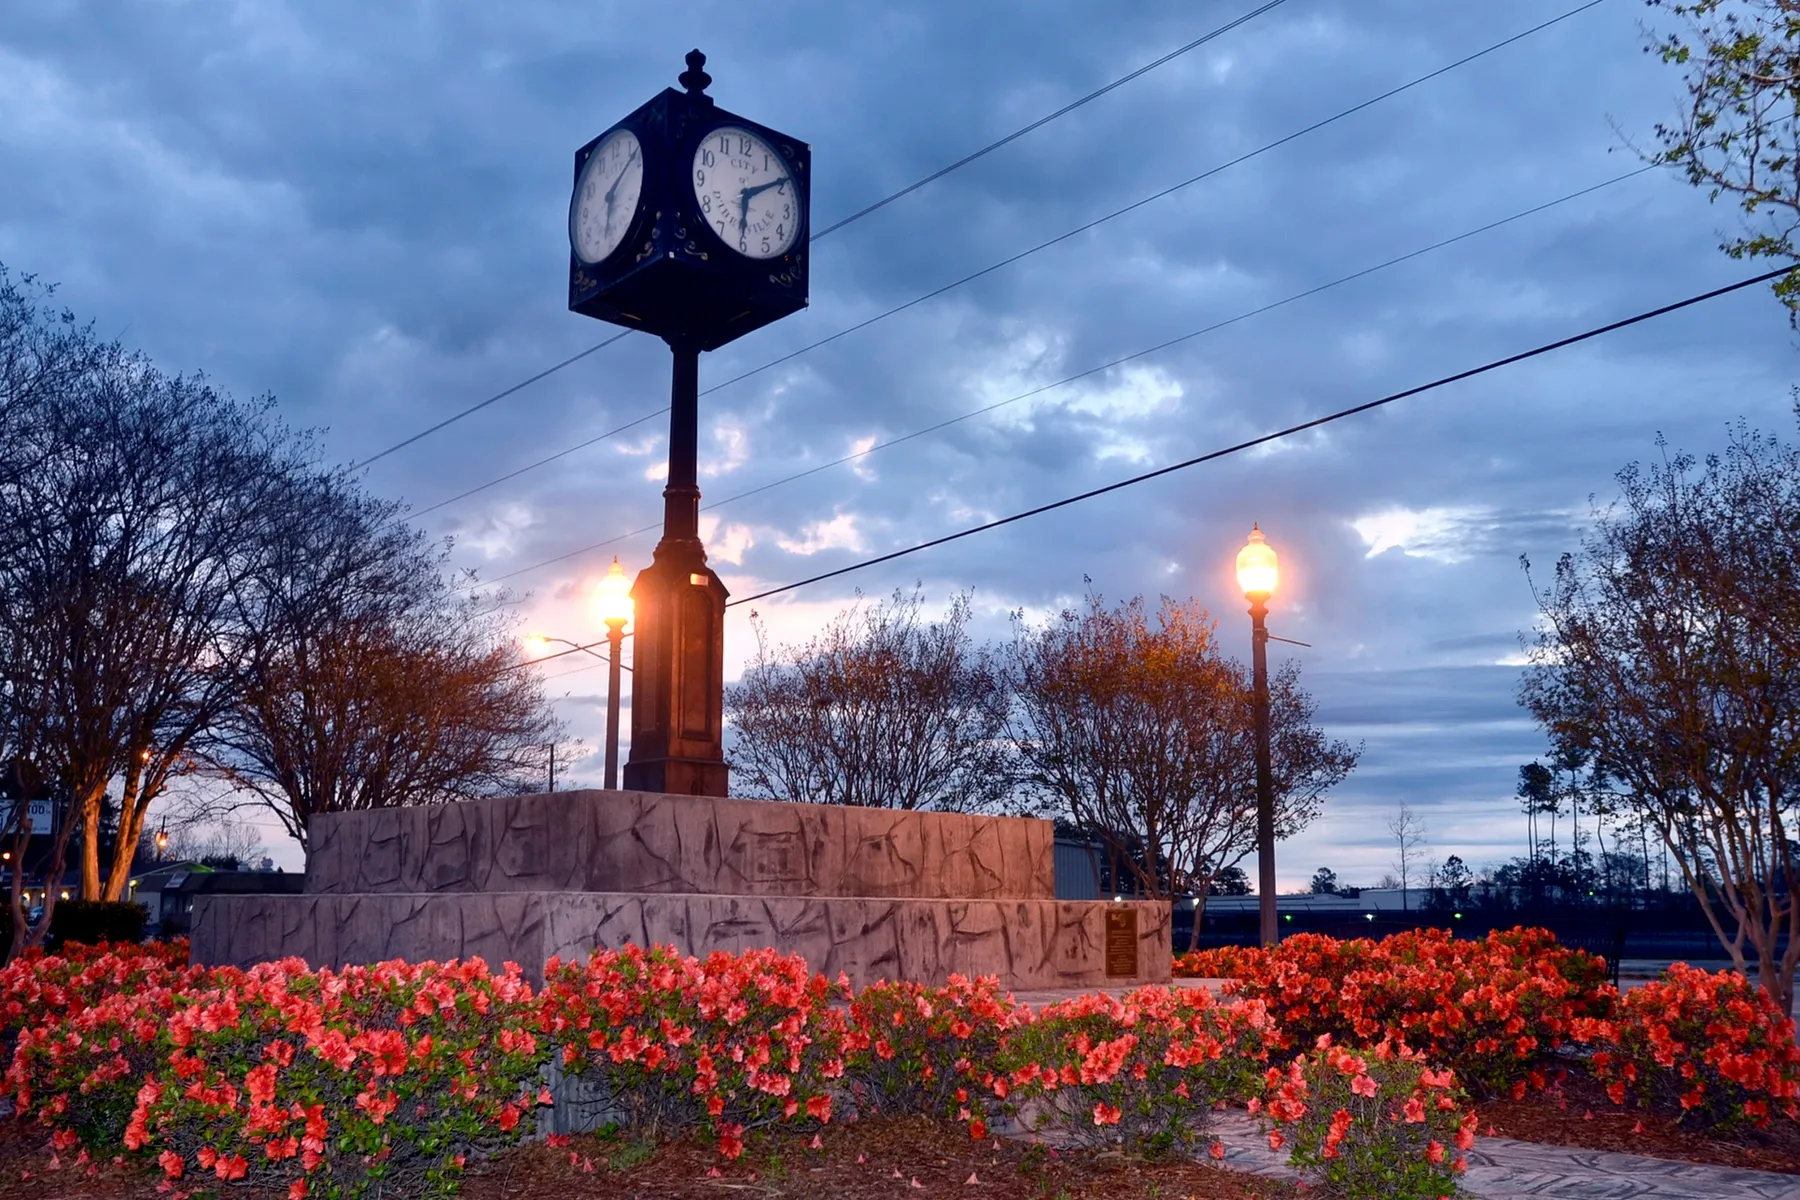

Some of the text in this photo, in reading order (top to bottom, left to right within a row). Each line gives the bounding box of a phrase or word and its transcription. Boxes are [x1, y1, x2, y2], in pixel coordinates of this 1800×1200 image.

[611, 140, 620, 160] 12
[719, 136, 730, 154] 11
[739, 137, 752, 158] 12
[597, 157, 606, 174] 11
[702, 148, 714, 168] 10
[730, 158, 758, 174] CITY
[763, 154, 768, 172] 1
[696, 169, 704, 186] 9
[585, 181, 596, 200] 10
[702, 195, 710, 214] 8
[713, 191, 775, 235] D'IBEVILLE
[782, 203, 790, 220] 3
[582, 207, 588, 224] 9
[715, 220, 724, 236] 7
[776, 223, 784, 240] 4
[739, 235, 748, 252] 6
[761, 236, 770, 252] 5
